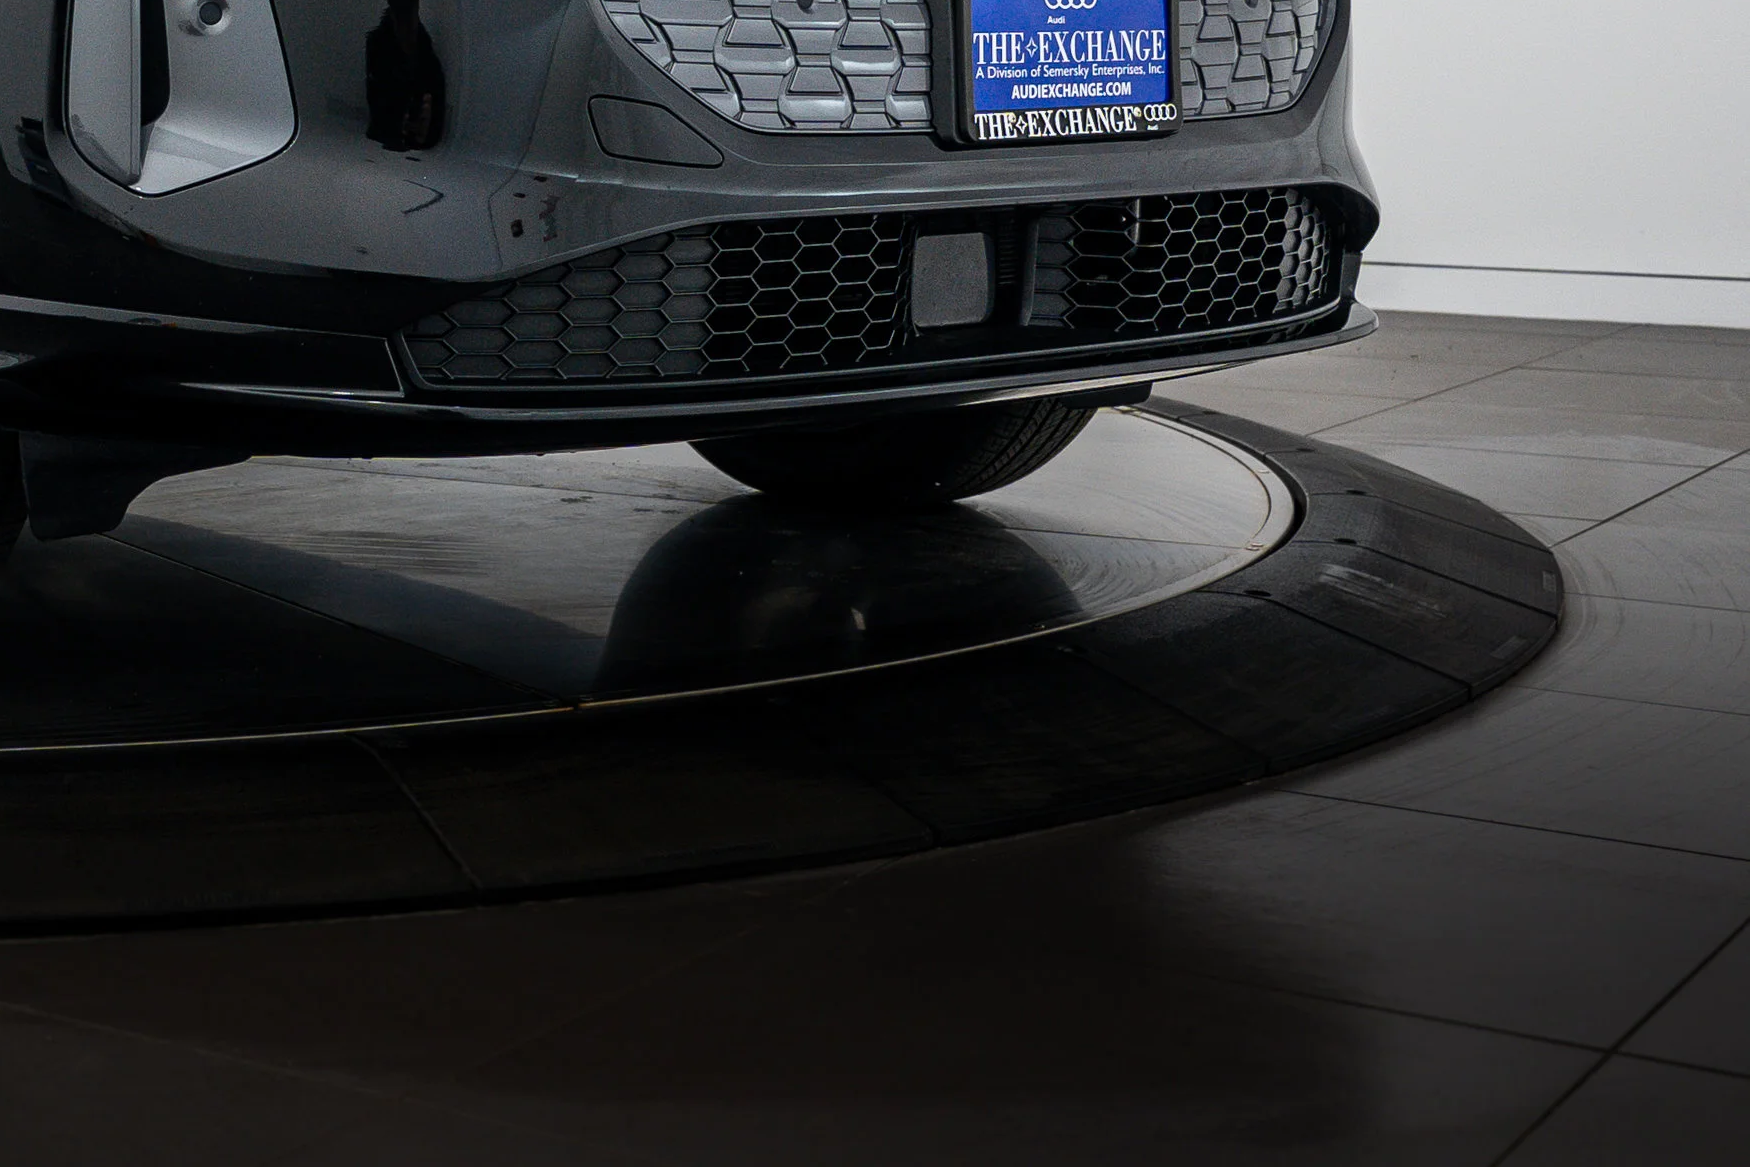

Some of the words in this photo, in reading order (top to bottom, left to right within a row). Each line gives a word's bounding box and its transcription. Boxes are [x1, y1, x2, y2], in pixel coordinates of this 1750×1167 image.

[1047, 15, 1066, 24] Audi
[973, 32, 1025, 65] THE
[1037, 29, 1166, 63] EXCHANGE
[975, 66, 985, 79] A
[987, 66, 1028, 79] Division
[1030, 64, 1042, 78] of
[1043, 64, 1089, 80] Semersky
[1092, 63, 1146, 79] Enterprises,
[1148, 62, 1165, 75] Inc.
[1011, 81, 1132, 100] AUDIEXCHANGE.COM
[974, 112, 1018, 140] THE
[1025, 106, 1137, 137] EXCHANGE
